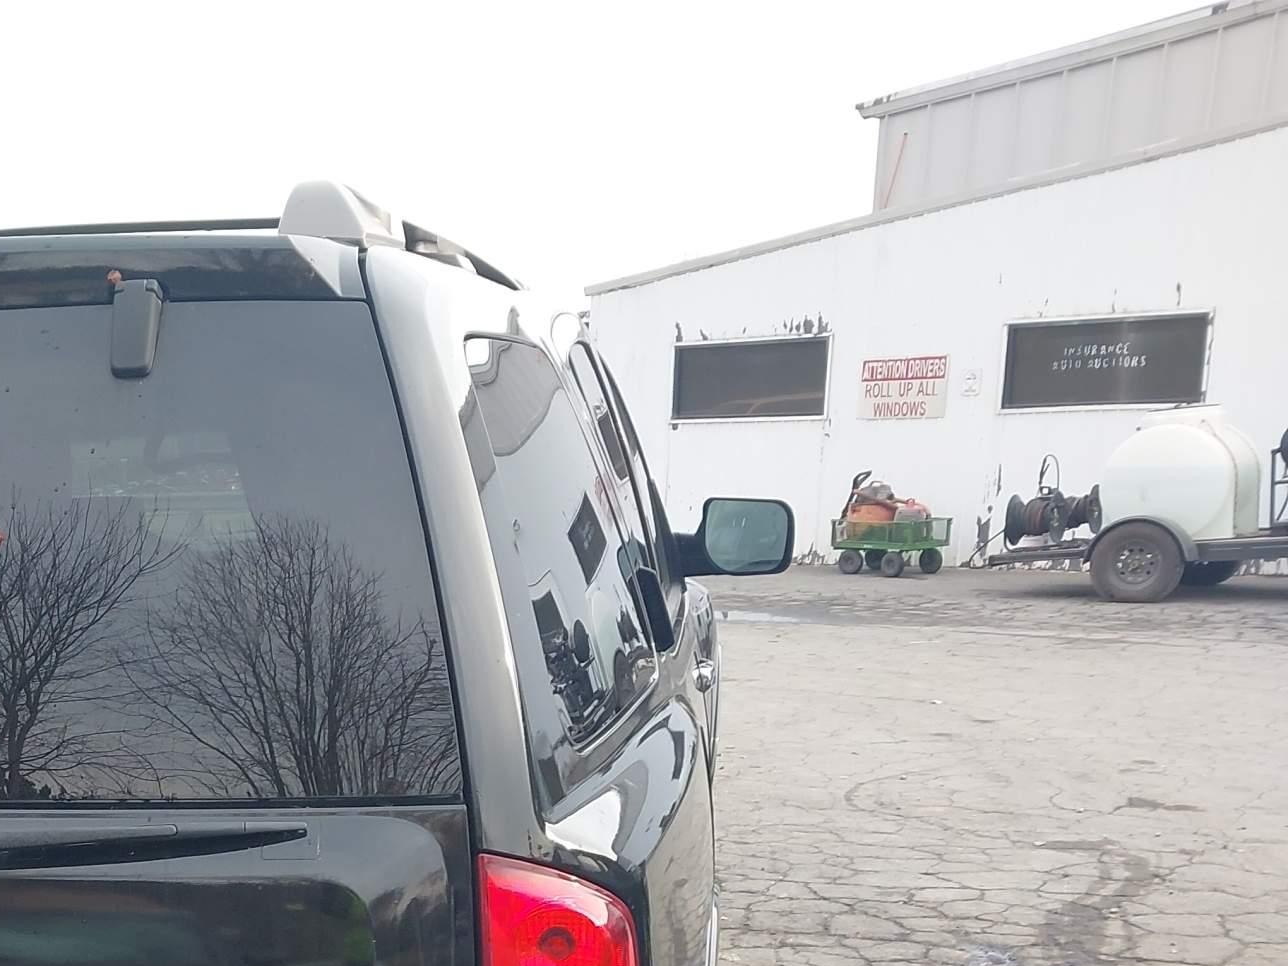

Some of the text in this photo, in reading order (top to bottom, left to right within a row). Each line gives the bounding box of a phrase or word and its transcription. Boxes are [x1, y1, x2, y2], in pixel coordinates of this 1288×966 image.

[1064, 342, 1130, 356] INSURANCE
[862, 358, 945, 380] ATTENTION DRIVERS
[865, 381, 938, 398] ROLL UP ALL
[873, 401, 926, 417] WINDOWS
